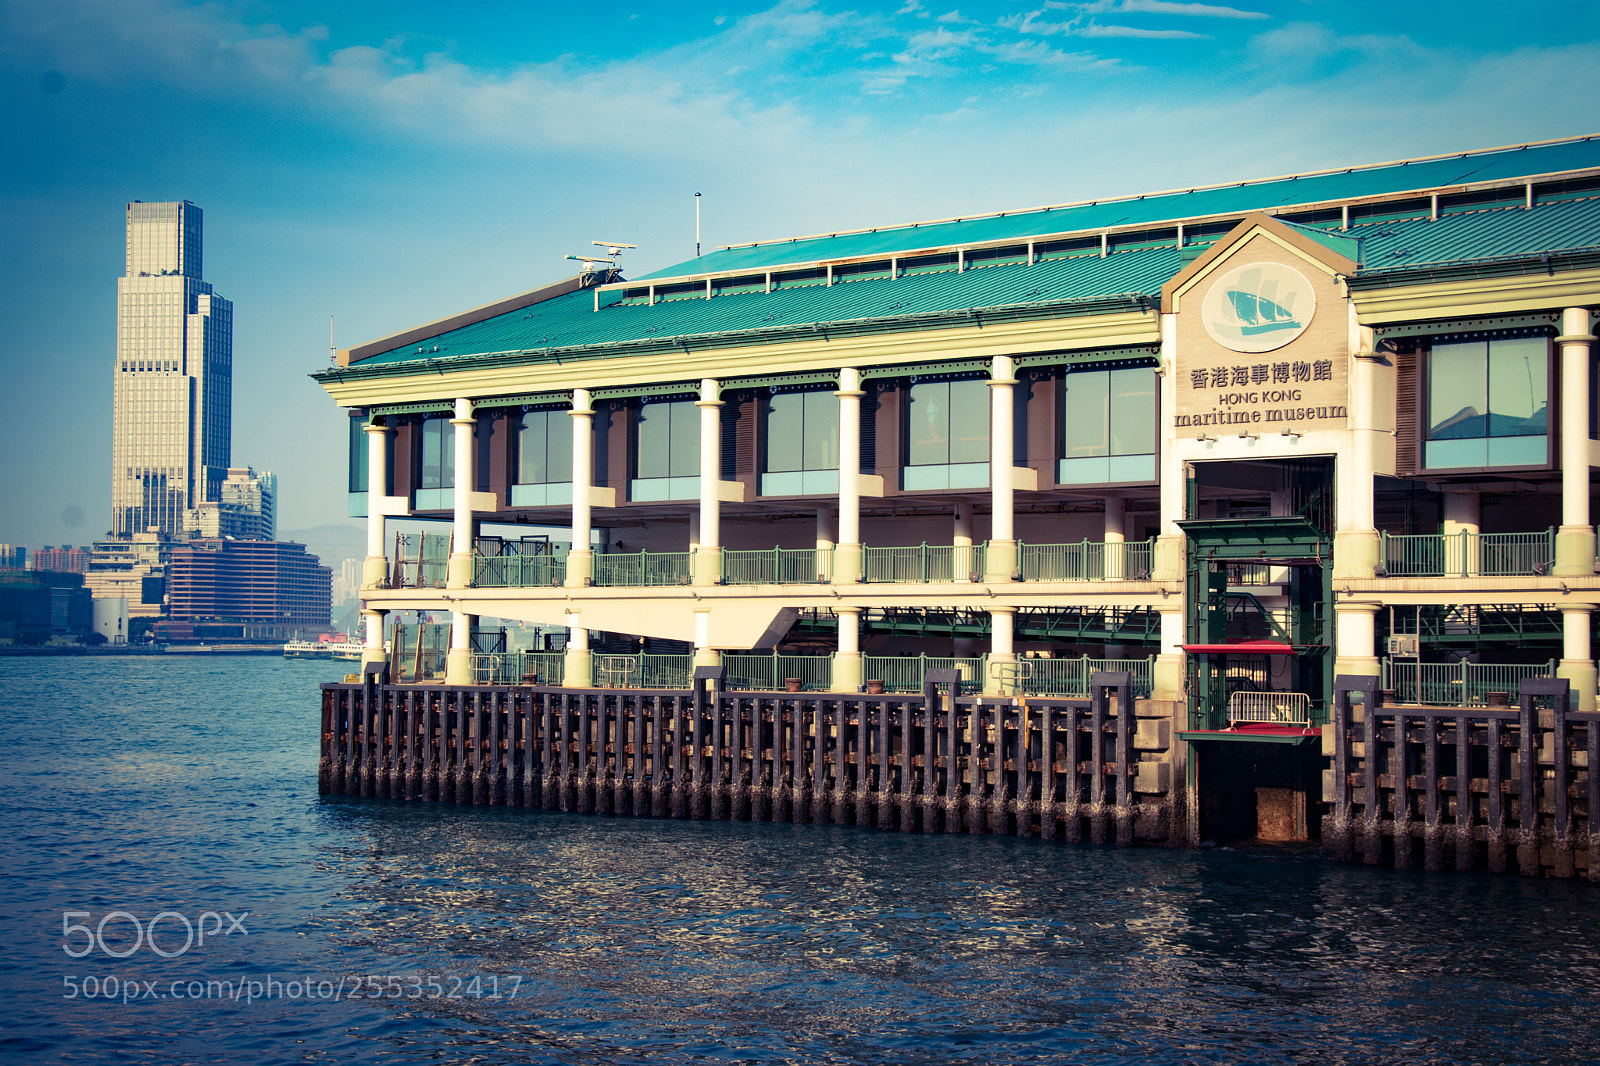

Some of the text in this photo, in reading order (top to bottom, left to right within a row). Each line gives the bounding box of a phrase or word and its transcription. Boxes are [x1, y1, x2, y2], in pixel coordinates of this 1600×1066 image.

[1190, 359, 1333, 389] 香港海事博物館
[1219, 389, 1302, 405] HONG KONG
[1174, 405, 1348, 427] maritime museum
